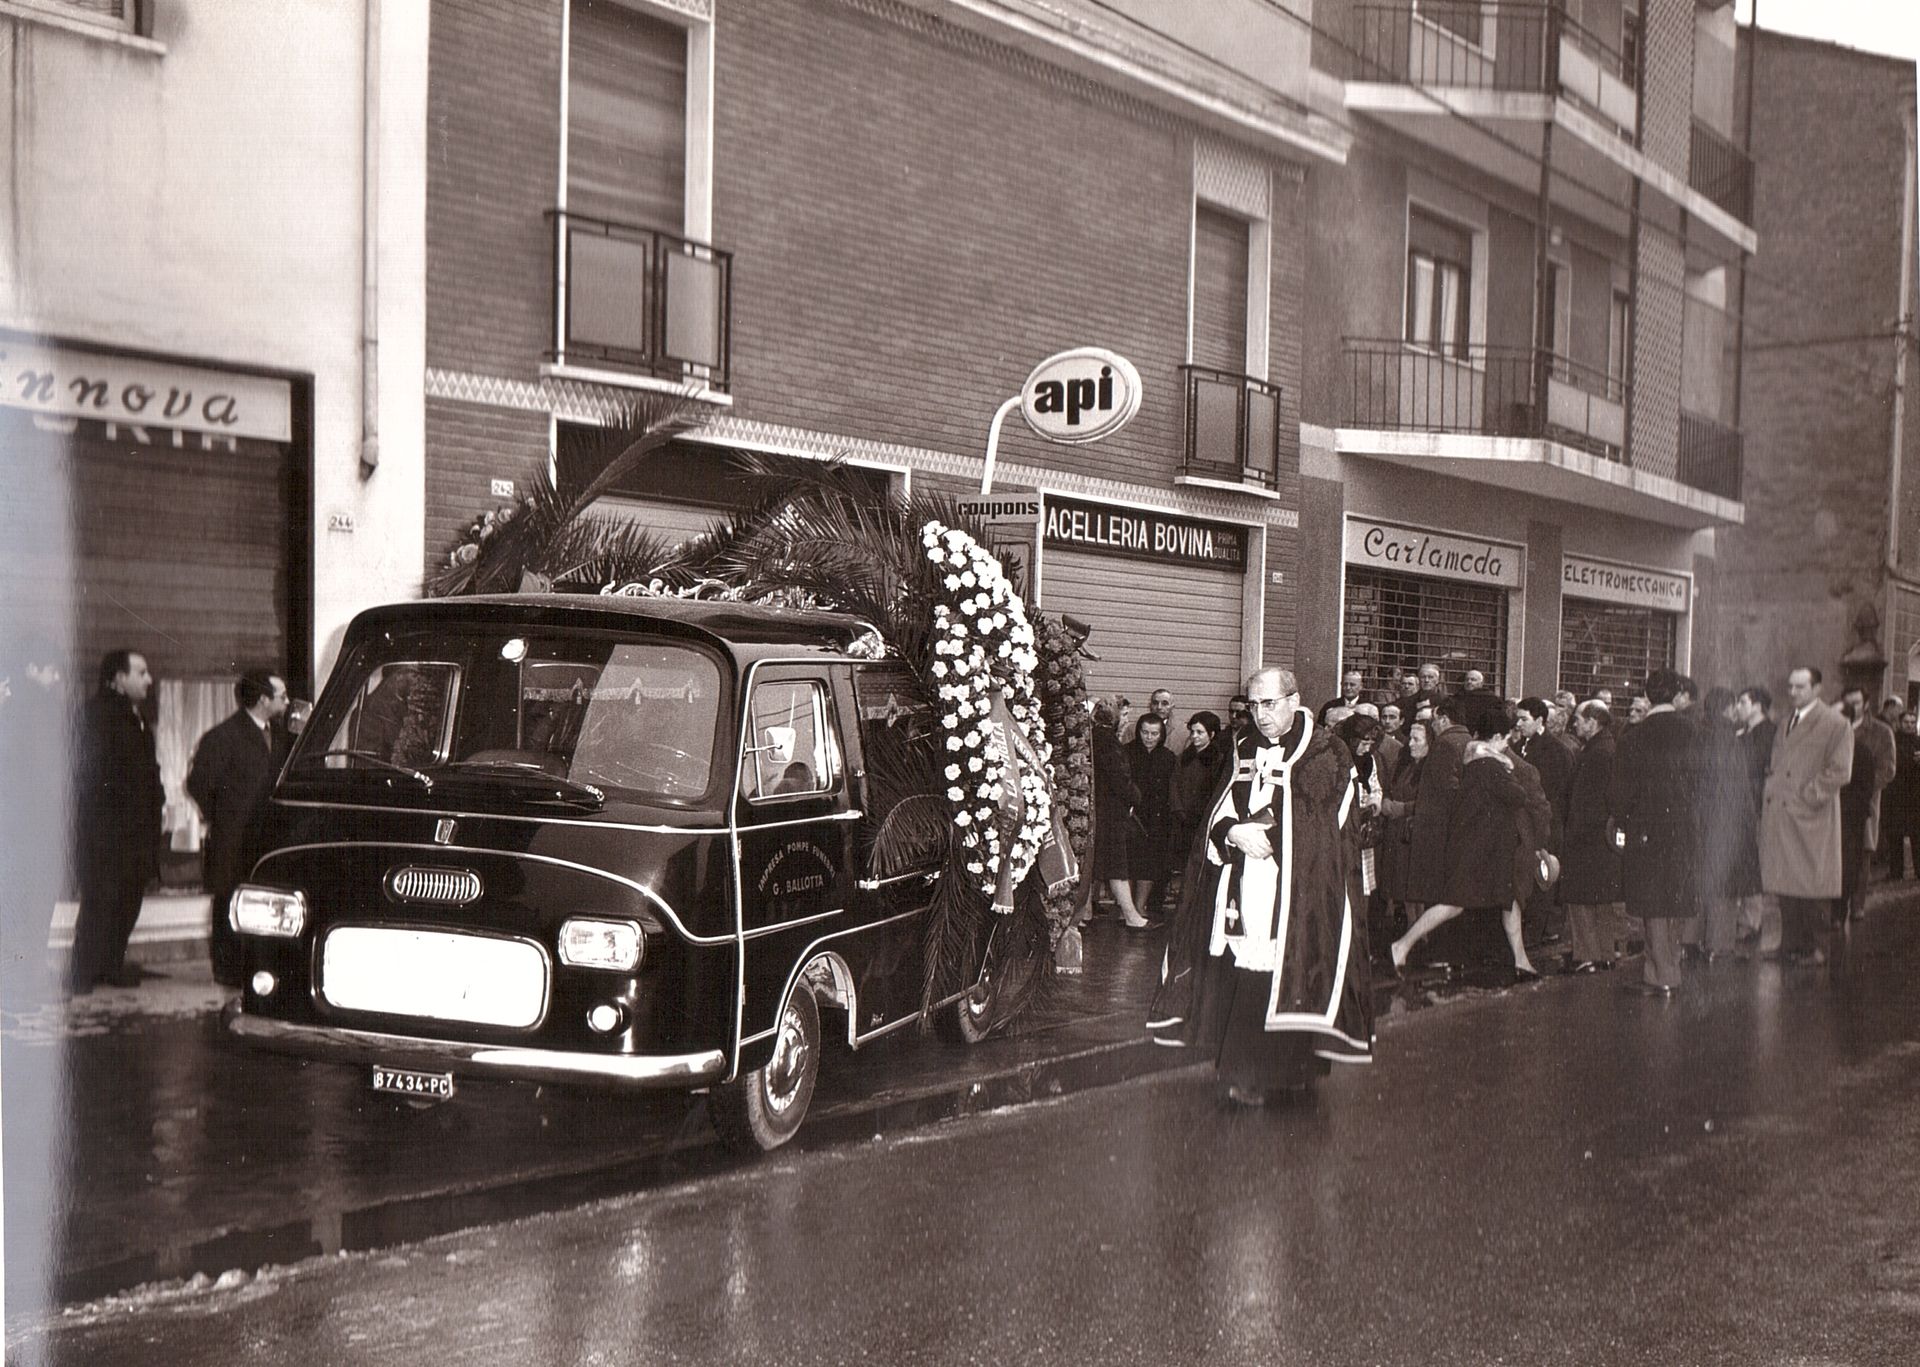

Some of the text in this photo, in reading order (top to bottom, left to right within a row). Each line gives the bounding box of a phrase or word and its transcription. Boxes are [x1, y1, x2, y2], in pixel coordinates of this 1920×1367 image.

[0, 350, 239, 425] nnova
[1034, 366, 1113, 425] api
[958, 502, 1039, 519] coupons
[1042, 505, 1213, 558] ACELLERIA BOVINA
[1564, 565, 1682, 598] ELETTROMECCANICA
[758, 849, 784, 892] IMPRESA
[787, 841, 809, 854] POMPE
[786, 874, 824, 893] BALLOTTA
